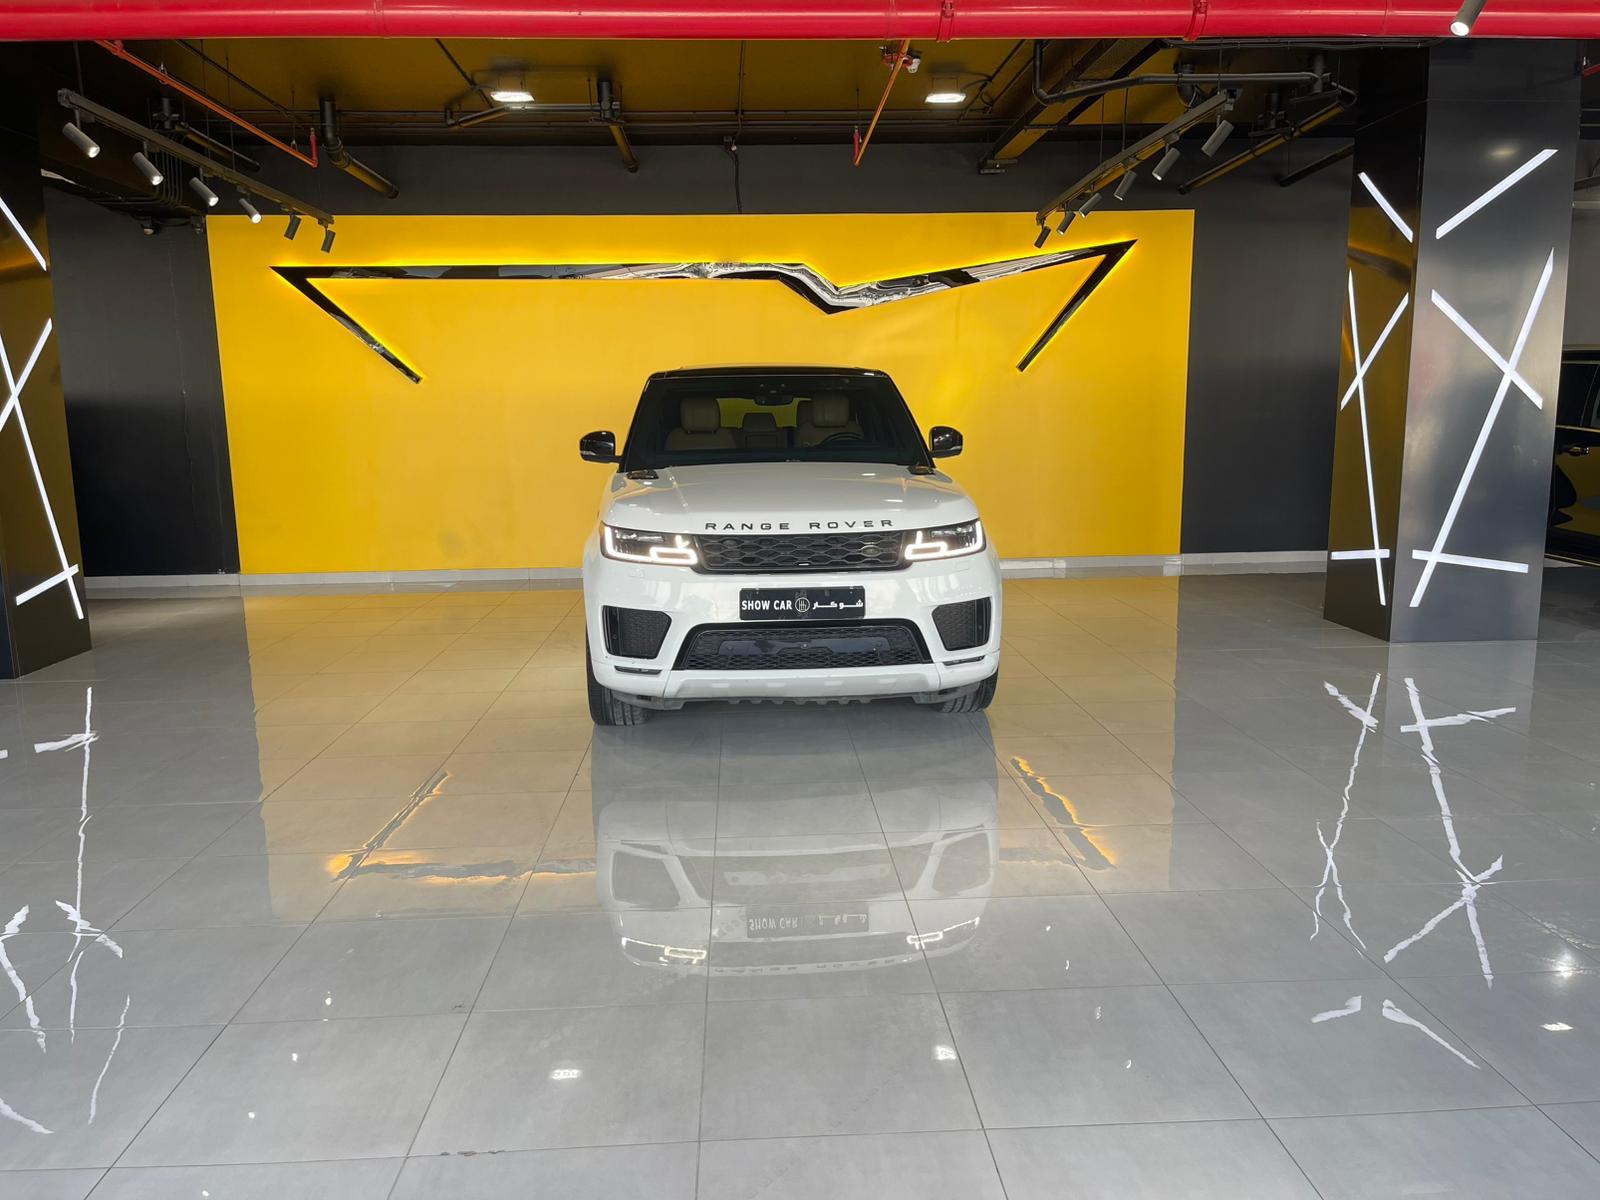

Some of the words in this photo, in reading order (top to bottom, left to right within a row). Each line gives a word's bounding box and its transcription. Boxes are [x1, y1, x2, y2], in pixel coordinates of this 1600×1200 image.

[705, 522, 790, 531] RANGE
[809, 519, 893, 530] ROVER
[741, 600, 771, 610] SHOW
[773, 600, 793, 610] CAR
